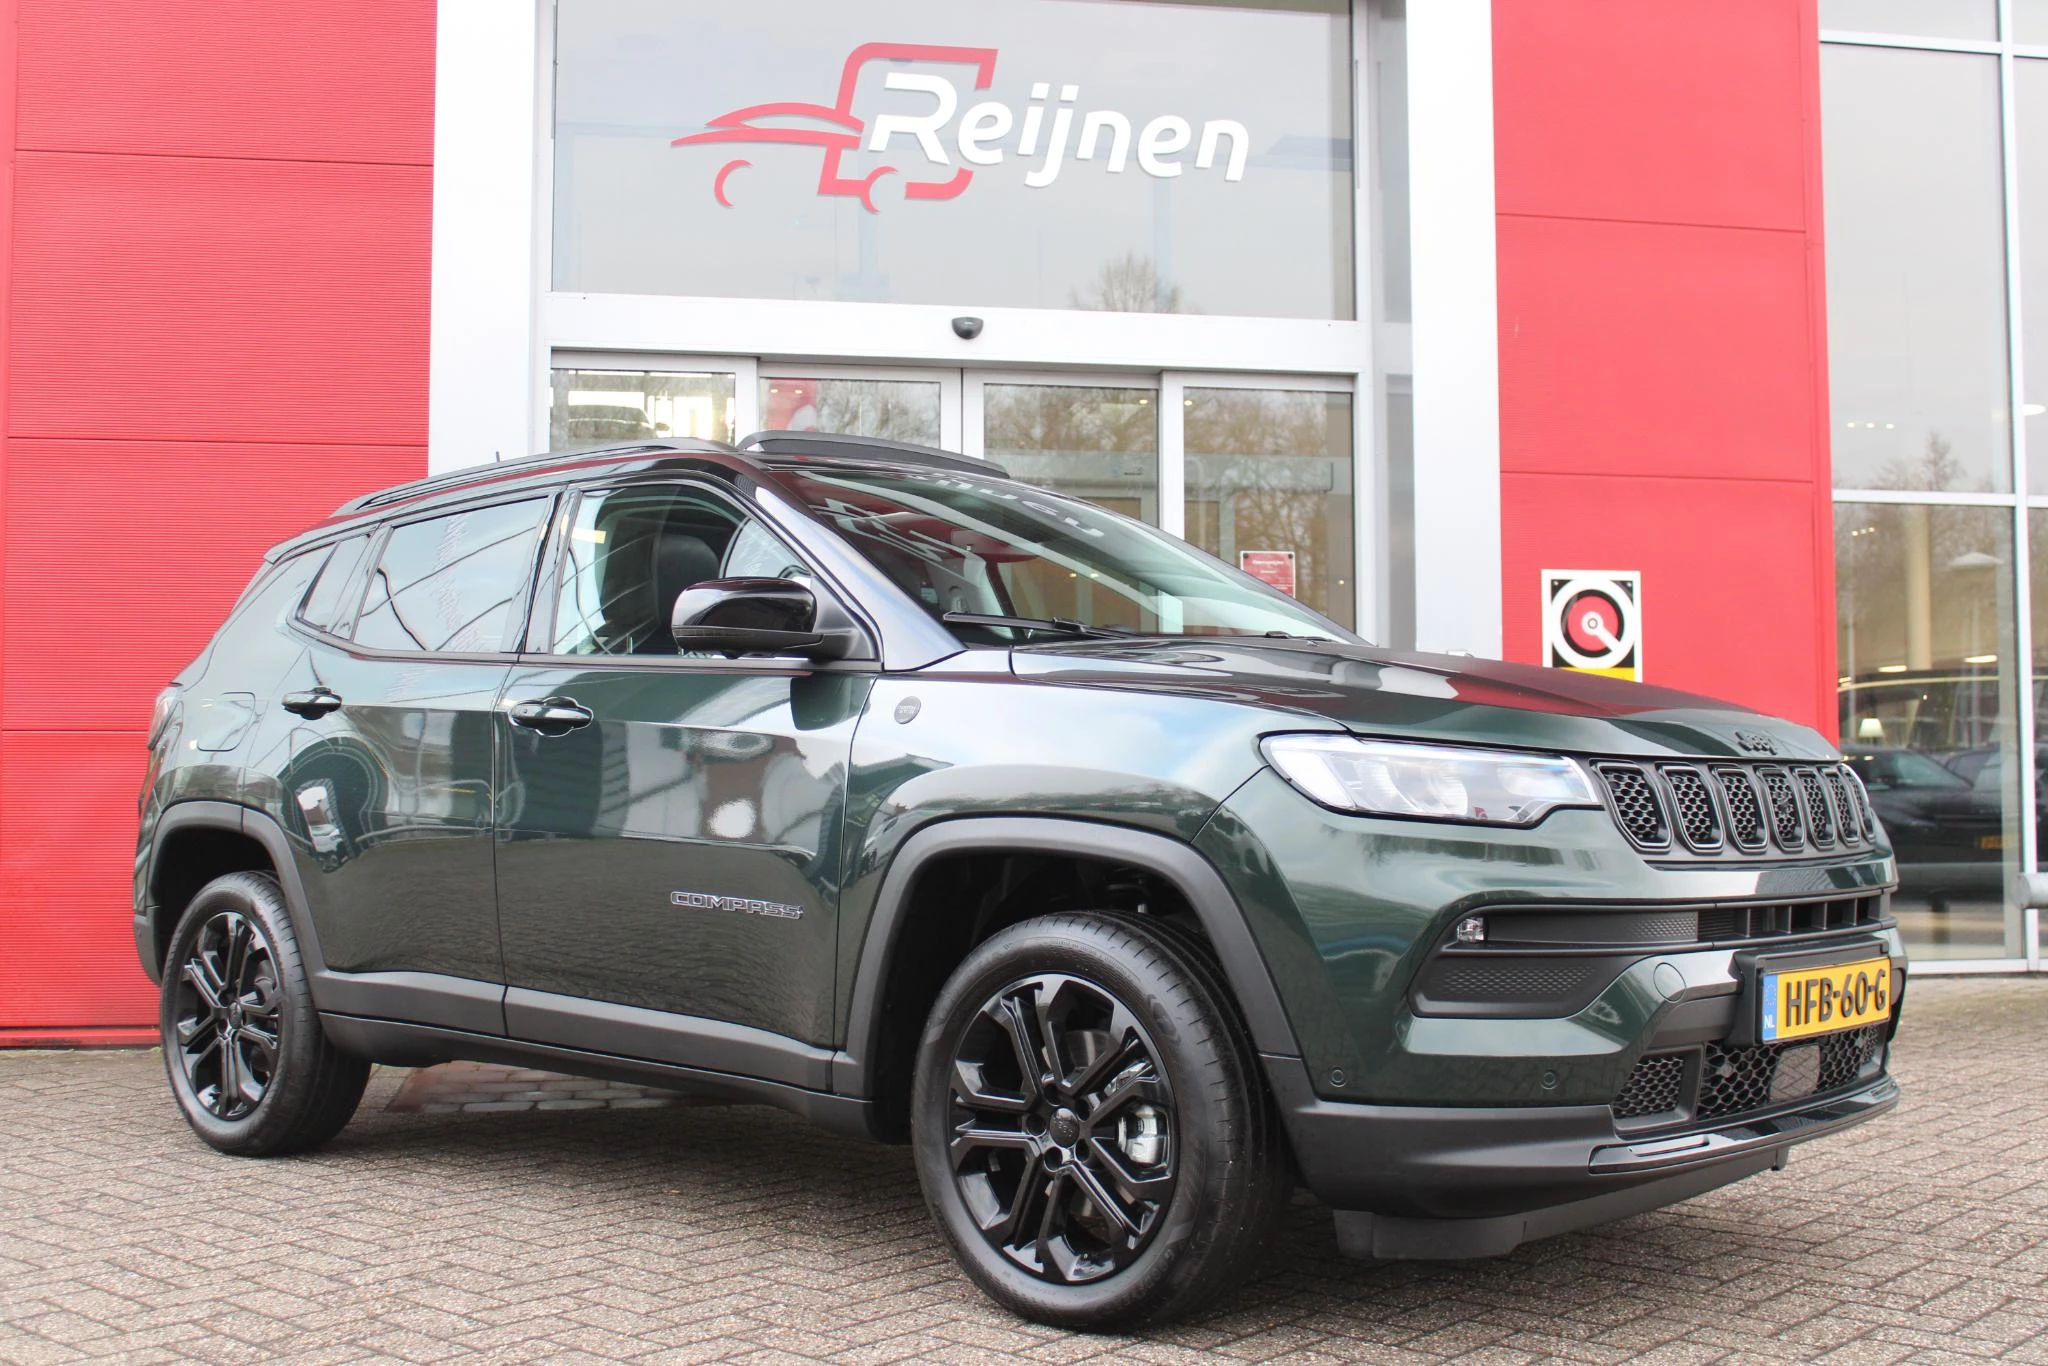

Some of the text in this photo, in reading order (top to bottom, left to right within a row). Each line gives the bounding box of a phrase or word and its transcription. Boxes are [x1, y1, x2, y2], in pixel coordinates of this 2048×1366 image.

[868, 72, 1250, 187] Reijnen
[671, 892, 803, 919] COMPASS
[1785, 968, 1887, 1028] HFB-60-G
[1763, 1014, 1776, 1029] NL
